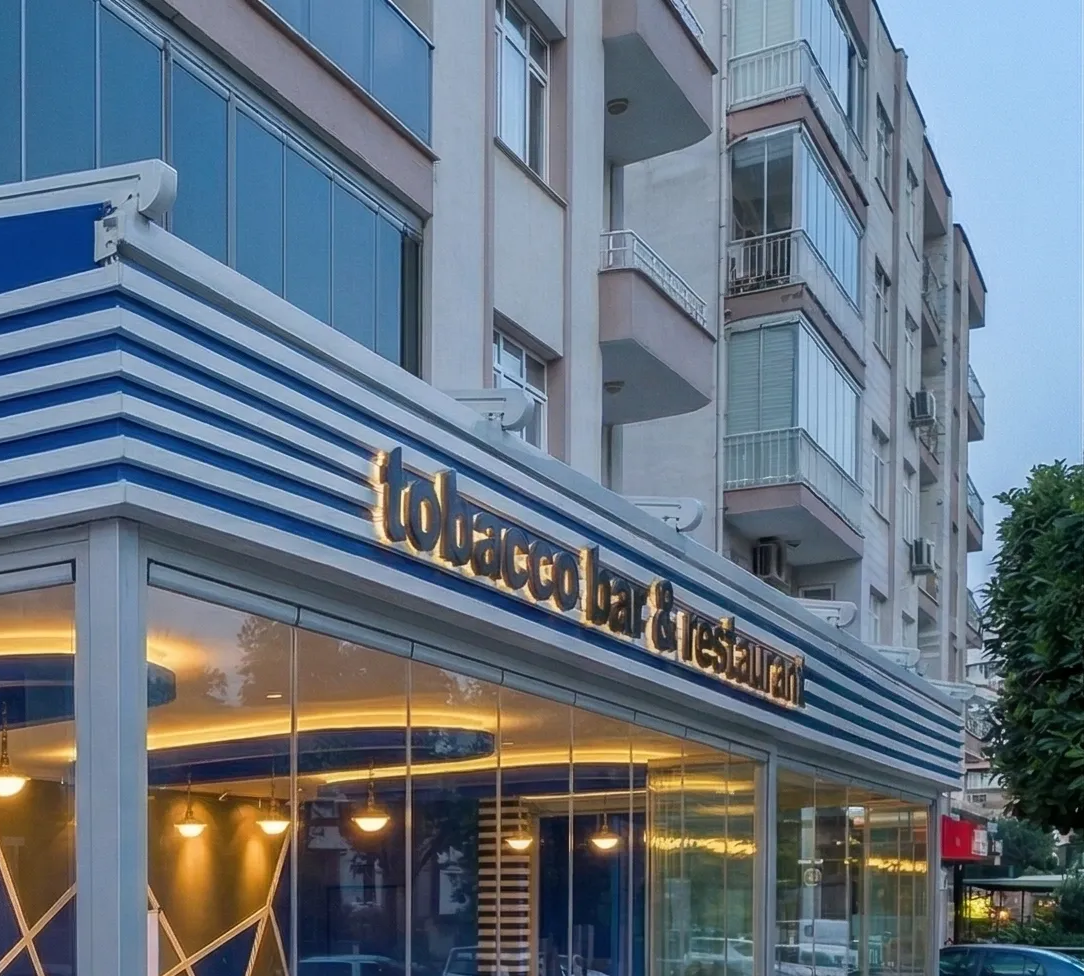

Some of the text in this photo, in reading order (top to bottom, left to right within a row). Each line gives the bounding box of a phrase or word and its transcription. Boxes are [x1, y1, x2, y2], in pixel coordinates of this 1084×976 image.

[376, 446, 805, 707] tobacco bar & restaurant
